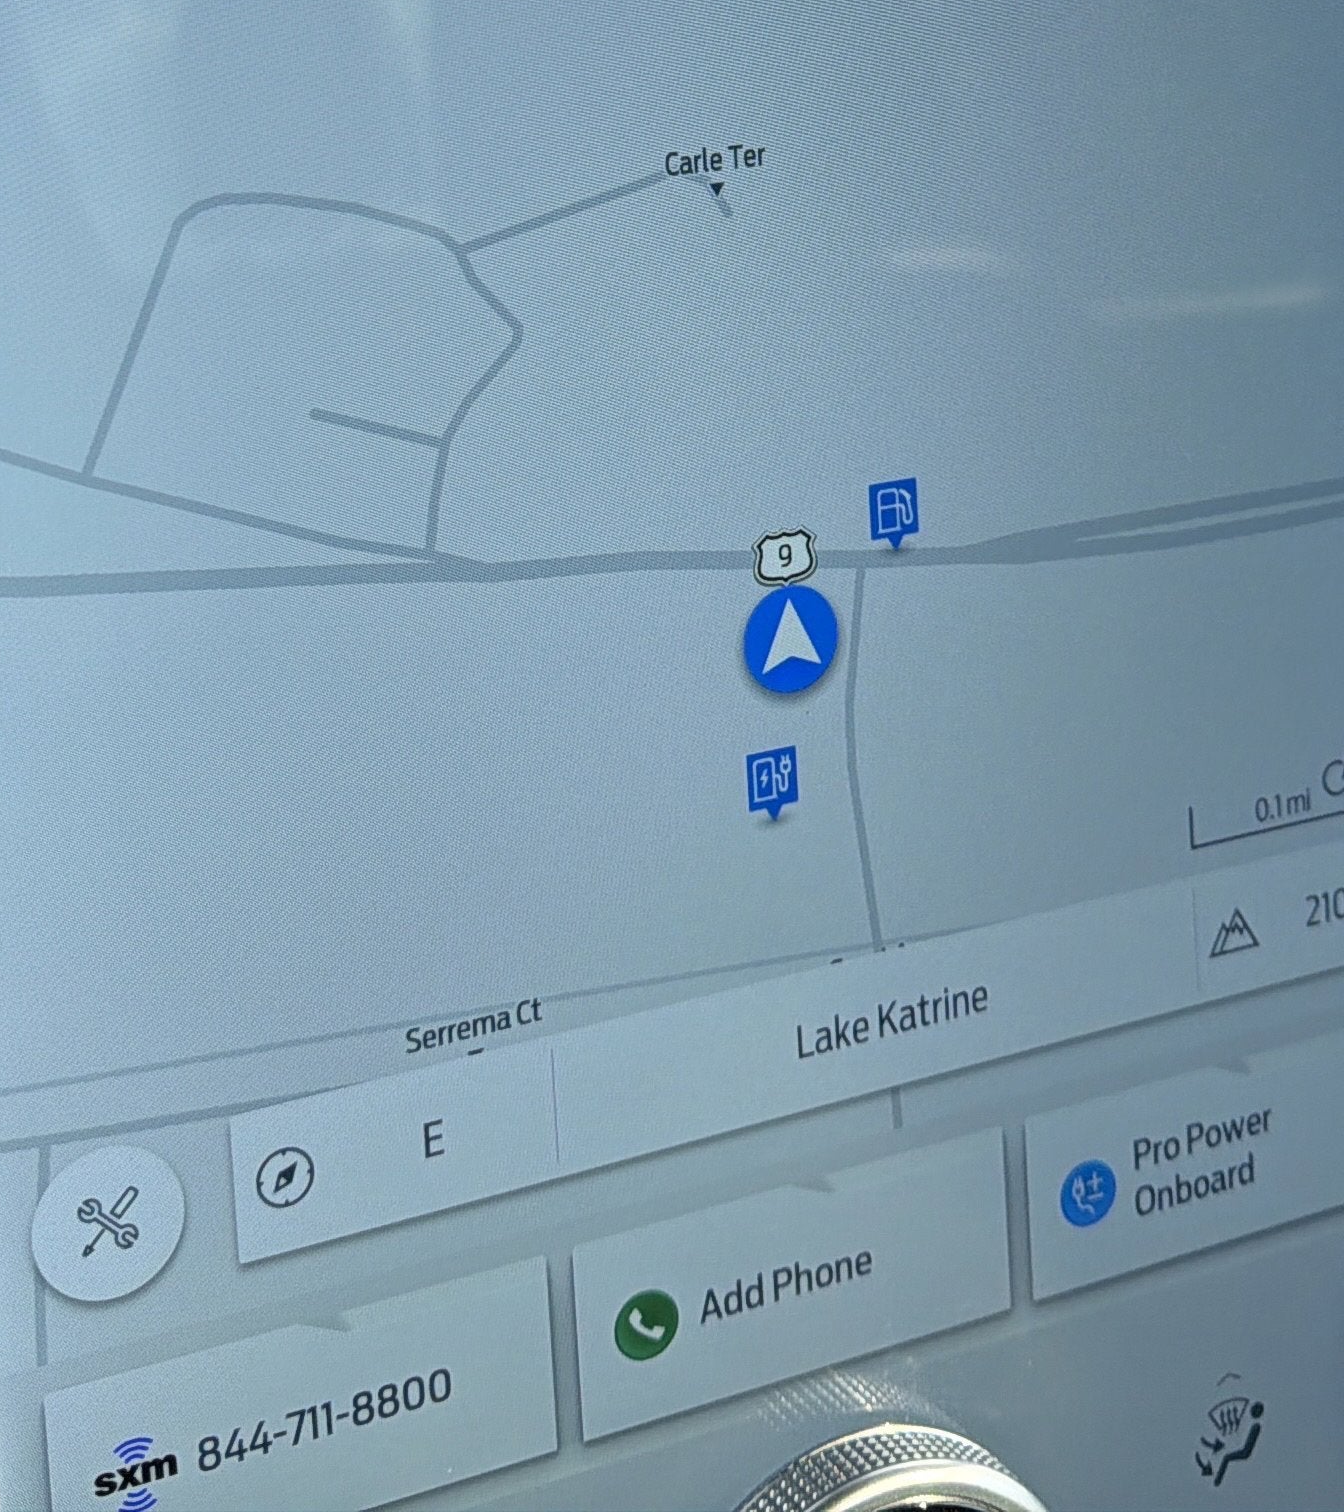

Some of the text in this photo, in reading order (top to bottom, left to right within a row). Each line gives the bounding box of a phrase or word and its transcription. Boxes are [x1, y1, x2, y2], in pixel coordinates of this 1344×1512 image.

[665, 144, 766, 176] Carle Ter
[778, 543, 793, 568] 9
[405, 997, 543, 1055] Serrema Ct
[796, 986, 989, 1059] Lake Katrine
[422, 1118, 445, 1159] E
[1133, 1108, 1272, 1170] Pro Power
[1134, 1152, 1256, 1217] Onboard
[700, 1250, 872, 1324] Add Phone
[197, 1368, 453, 1473] 844-711-8800
[93, 1451, 179, 1498] sxm
